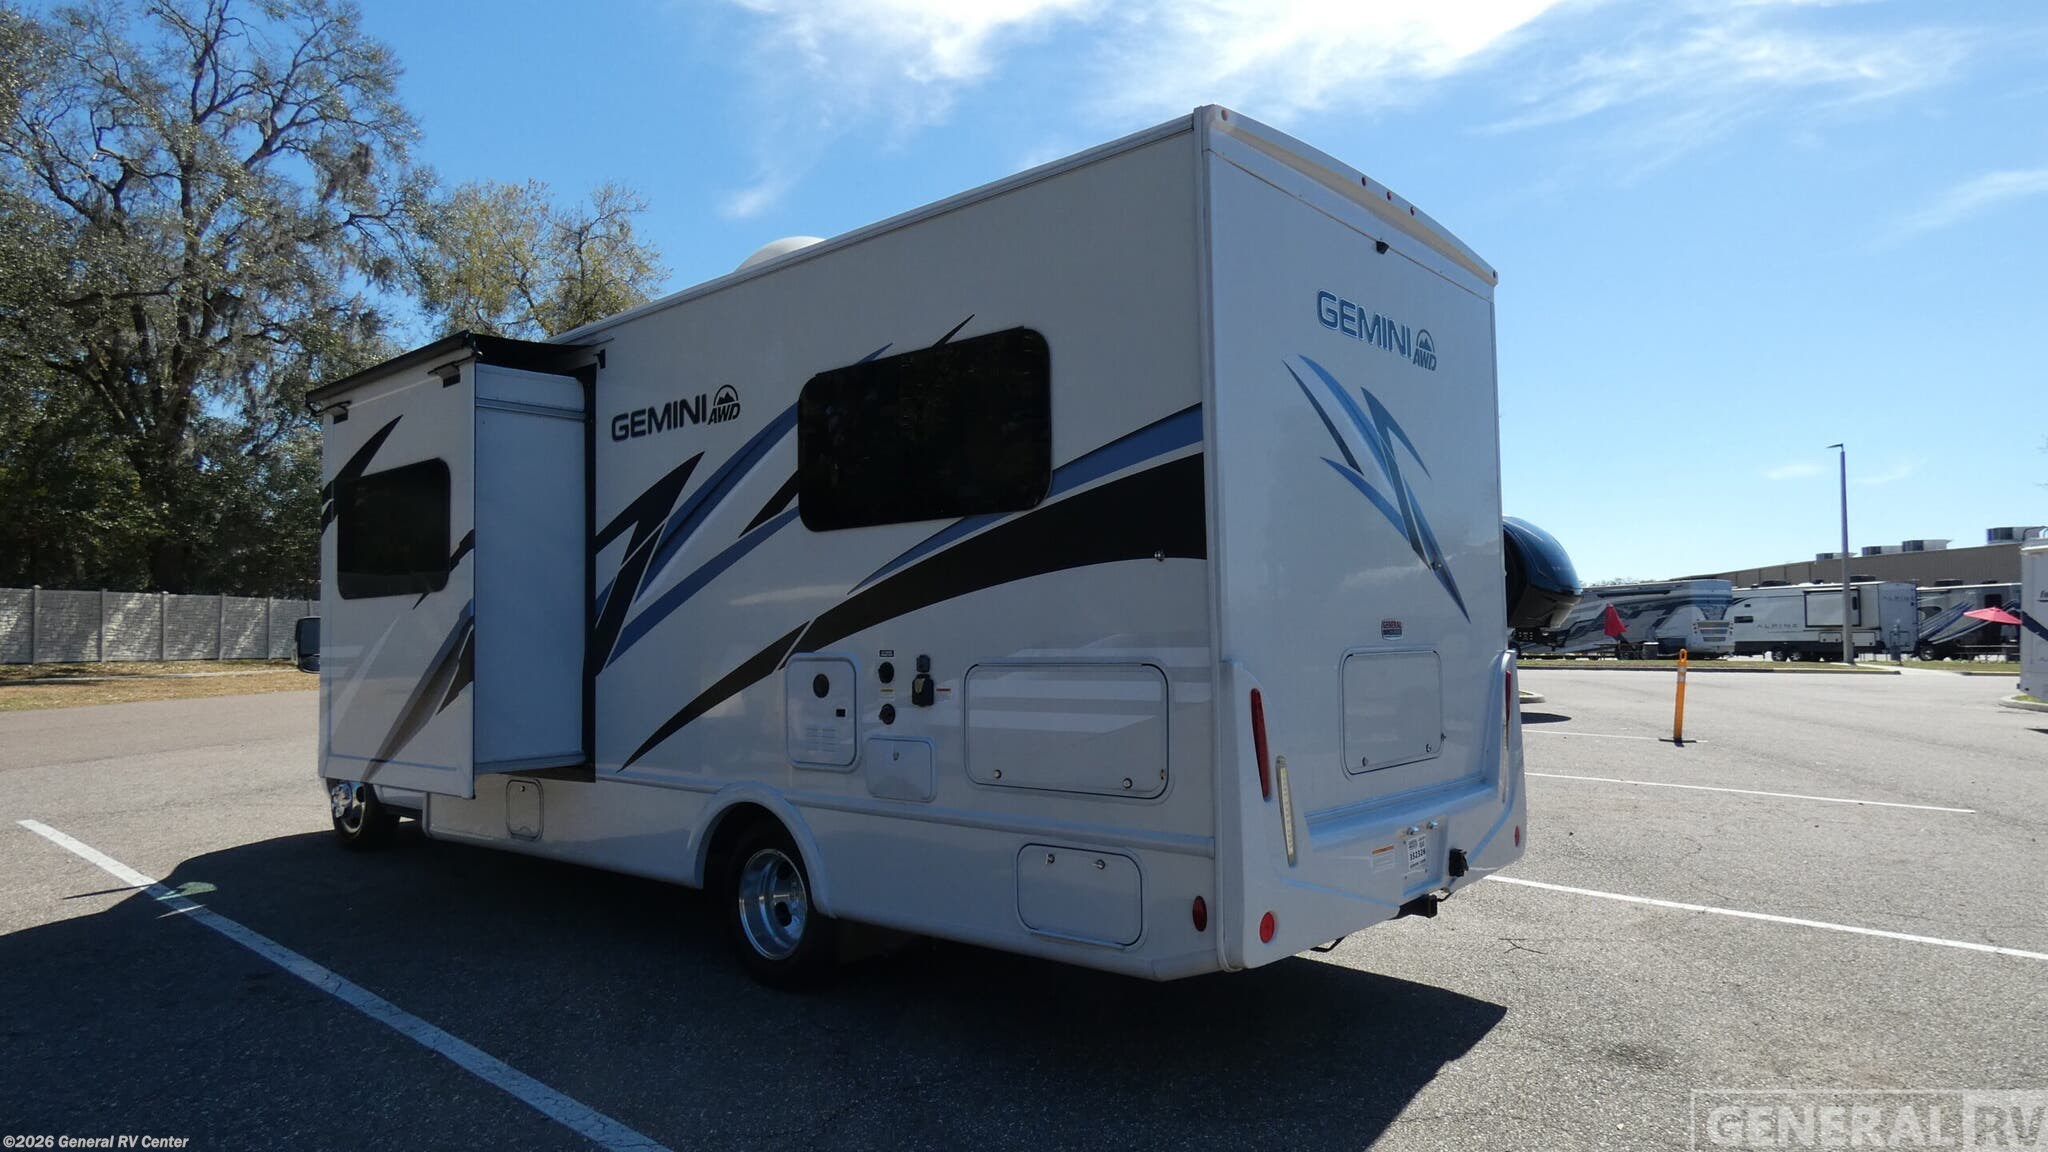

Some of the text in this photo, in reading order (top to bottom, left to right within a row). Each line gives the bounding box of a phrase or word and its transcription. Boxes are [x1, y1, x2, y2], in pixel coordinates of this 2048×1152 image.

[1317, 289, 1437, 371] GEMINI AWD
[611, 393, 741, 442] GEMINI AWD
